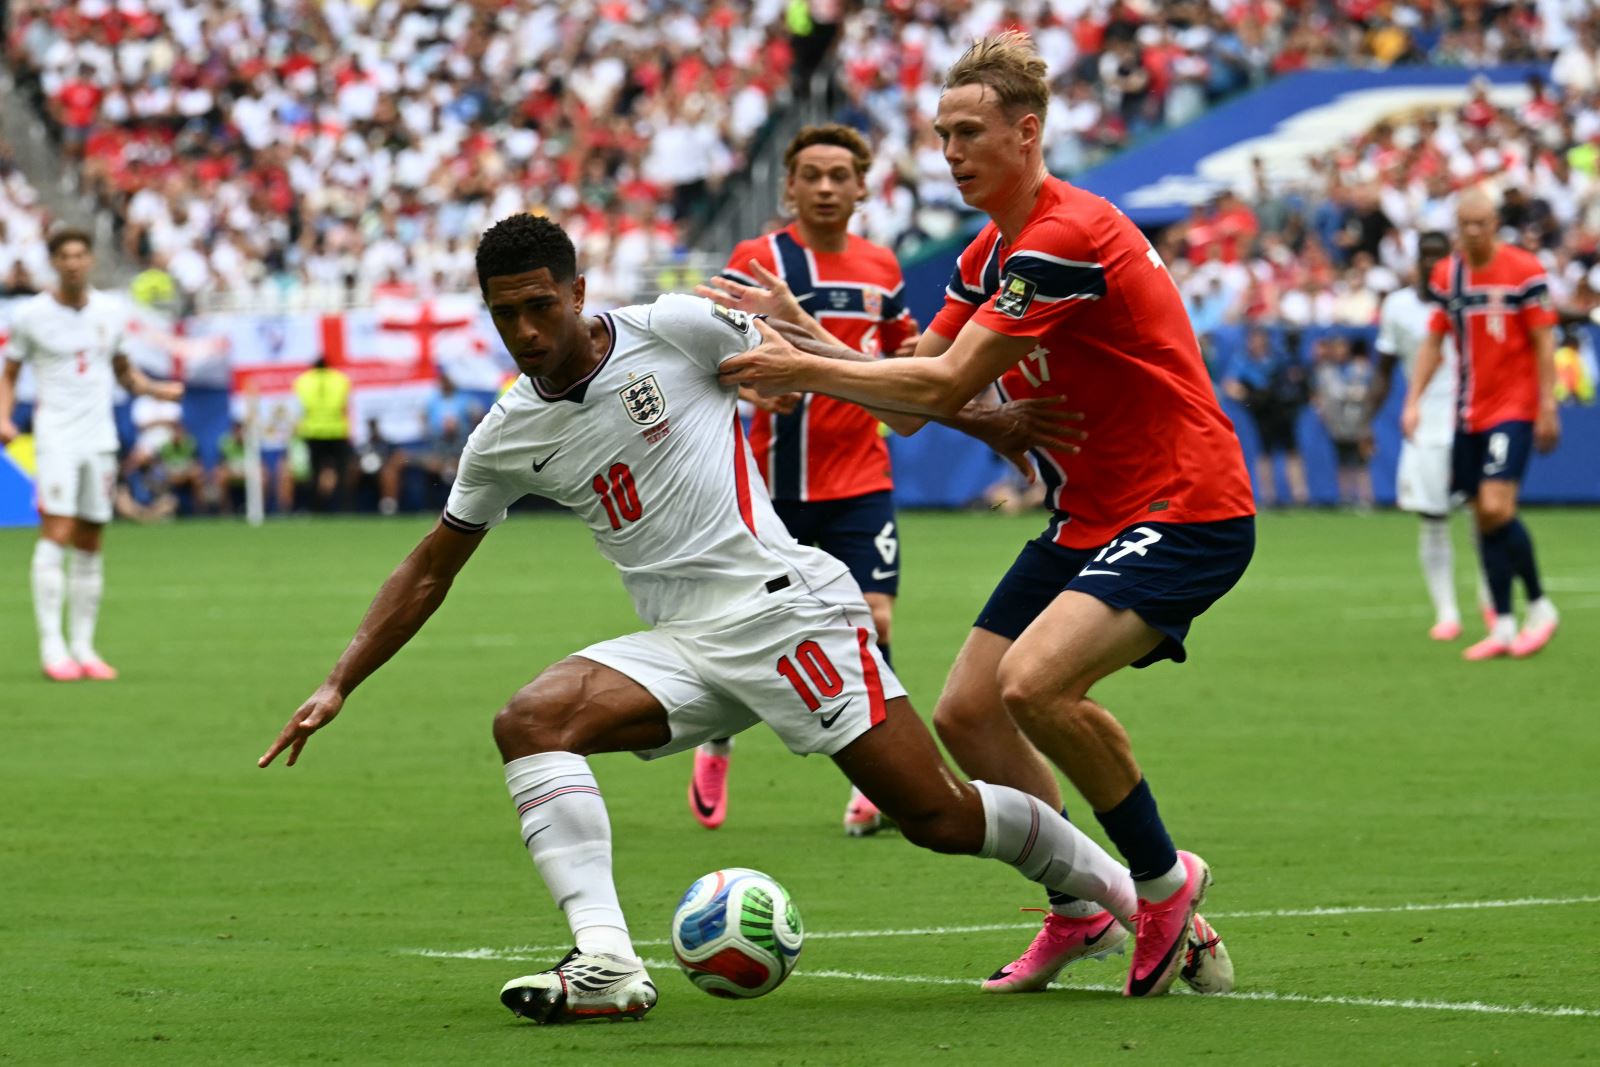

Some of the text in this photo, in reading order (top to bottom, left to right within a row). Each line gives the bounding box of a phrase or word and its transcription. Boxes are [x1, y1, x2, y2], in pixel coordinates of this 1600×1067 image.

[592, 462, 643, 531] 10
[874, 521, 897, 565] 6
[1093, 527, 1163, 565] 17
[776, 639, 844, 713] 10
